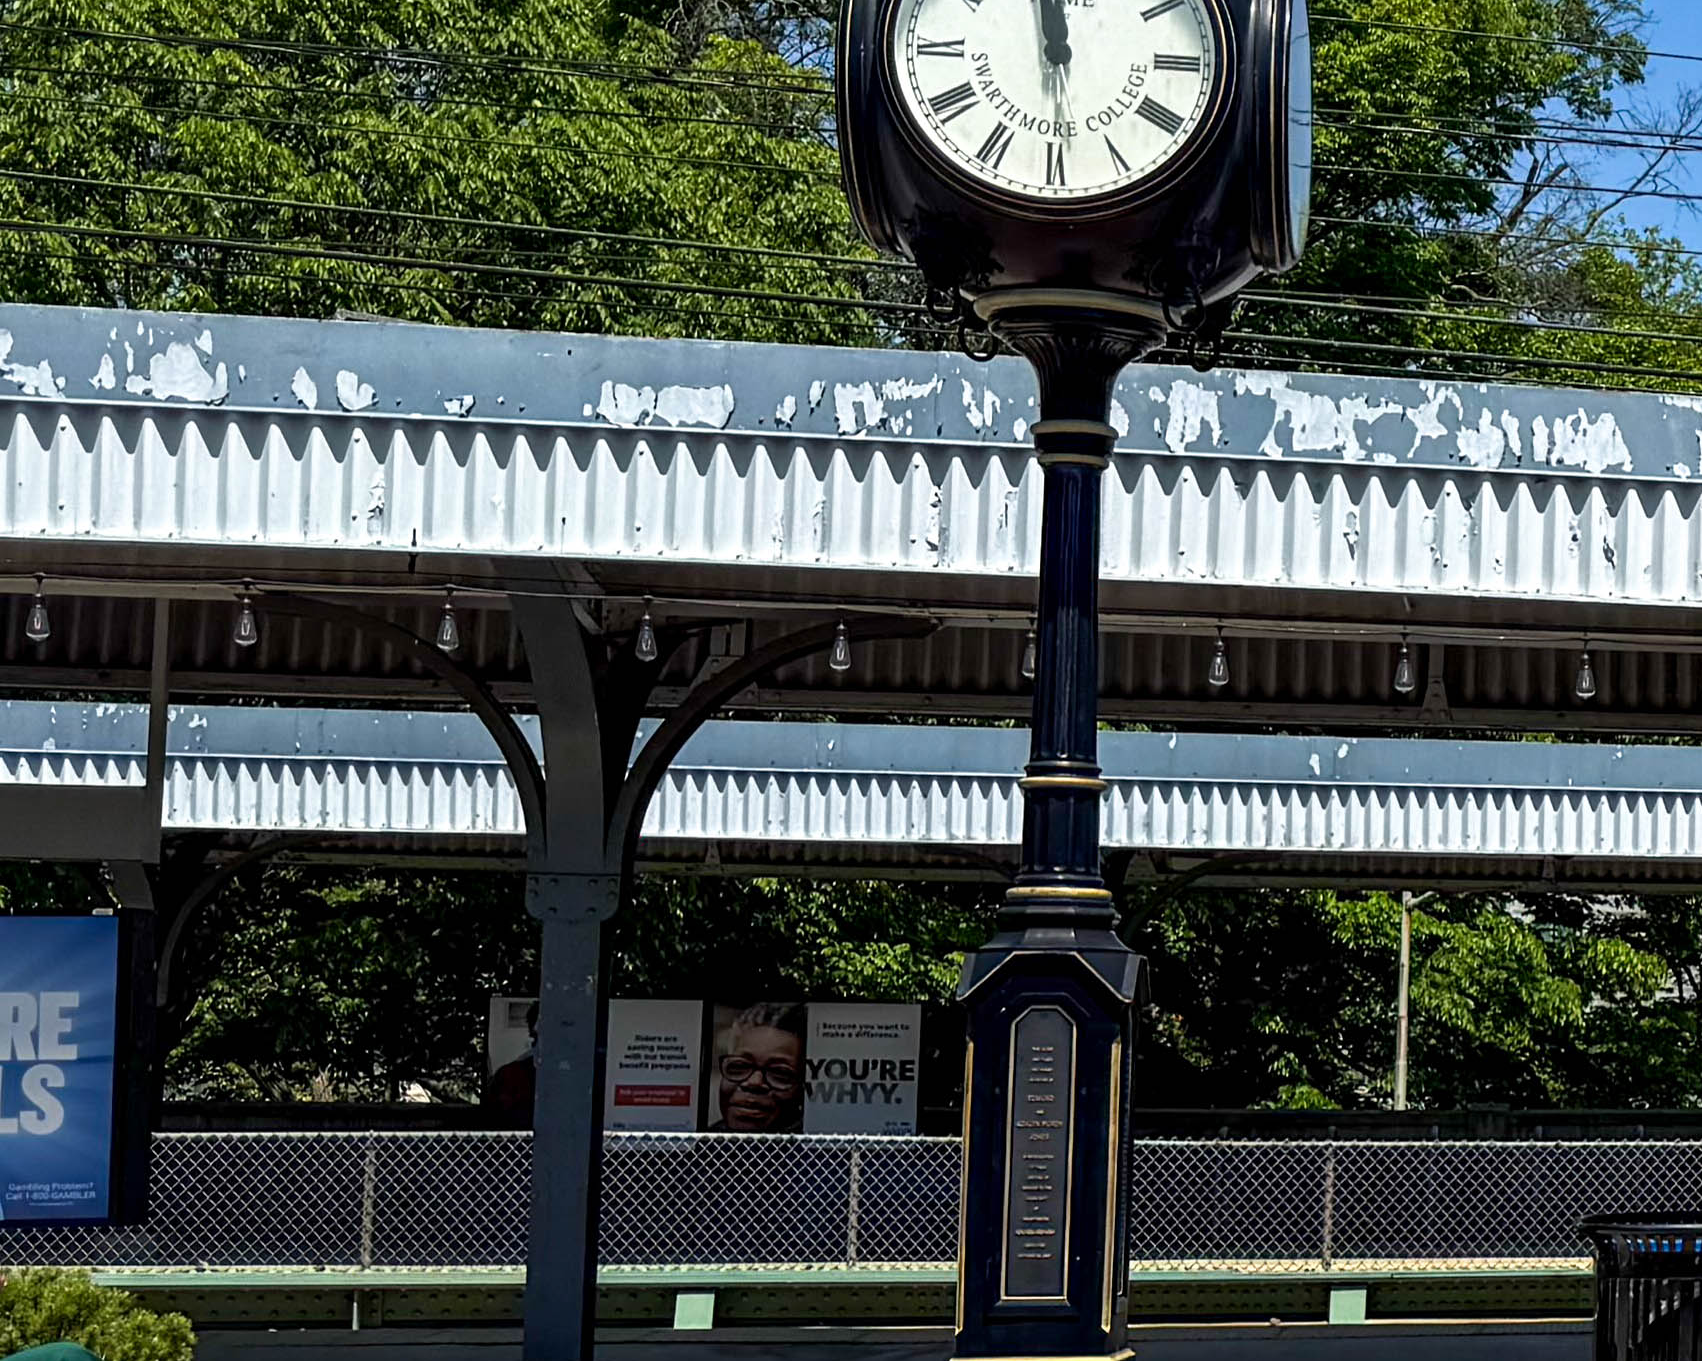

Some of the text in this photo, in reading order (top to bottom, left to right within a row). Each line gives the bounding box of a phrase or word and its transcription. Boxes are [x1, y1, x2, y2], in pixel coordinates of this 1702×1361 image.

[971, 52, 1147, 137] SWARTHMORE COLLEGE
[823, 1022, 856, 1030] Because
[859, 1023, 874, 1031] you
[805, 1058, 915, 1081] YOU'RE
[803, 1081, 902, 1104] WHYY.
[8, 1182, 94, 1192] Gambling Problem?
